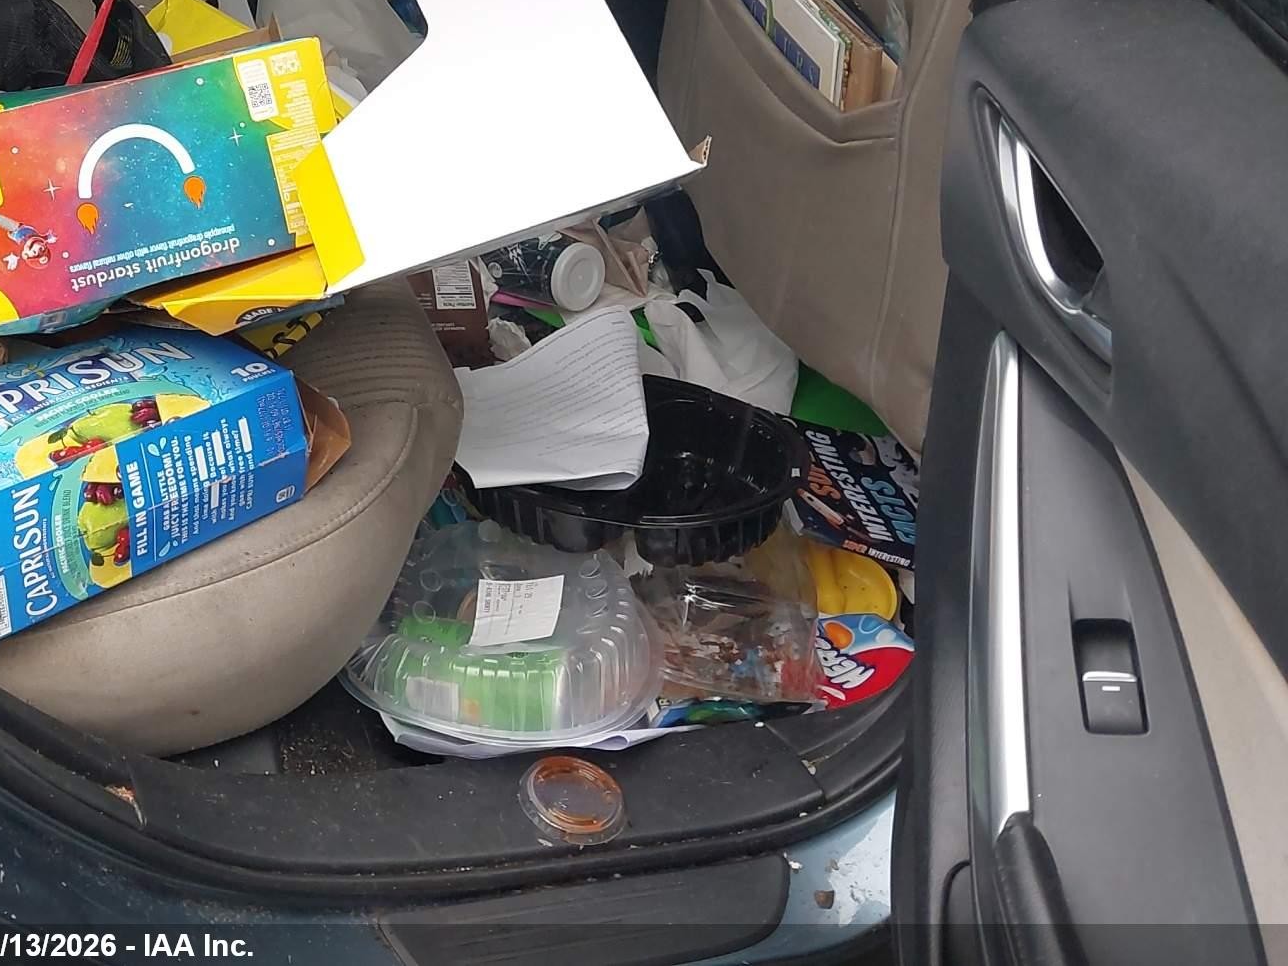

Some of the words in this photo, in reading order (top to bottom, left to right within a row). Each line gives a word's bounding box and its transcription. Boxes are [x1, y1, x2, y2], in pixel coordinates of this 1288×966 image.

[168, 229, 205, 250] dragonfruit
[204, 225, 236, 240] pineapple
[134, 244, 149, 258] with
[145, 237, 241, 276] dragonfruit
[148, 238, 170, 254] flavor
[70, 261, 142, 293] stardust
[231, 362, 269, 378] 10
[202, 431, 210, 441] it
[221, 418, 231, 449] always
[232, 430, 242, 454] time?
[170, 436, 180, 460] YOU.
[184, 435, 197, 477] spending
[206, 441, 217, 478] Because
[175, 460, 185, 480] FOR
[226, 450, 236, 473] what
[237, 455, 245, 473] free
[246, 453, 254, 470] and
[125, 461, 145, 509] GAME
[157, 470, 169, 502] LITTLE
[162, 452, 179, 513] FREEDOM!
[179, 480, 188, 502] TIME
[192, 478, 200, 503] means
[805, 430, 895, 542] INTERESTING
[135, 511, 147, 527] IN
[162, 509, 170, 531] GRAB
[171, 514, 180, 538] JUICY
[181, 518, 188, 526] IS
[192, 520, 200, 534] And
[136, 527, 148, 556] FILL
[842, 539, 868, 554] SUPER
[867, 548, 911, 566] INTERESTING
